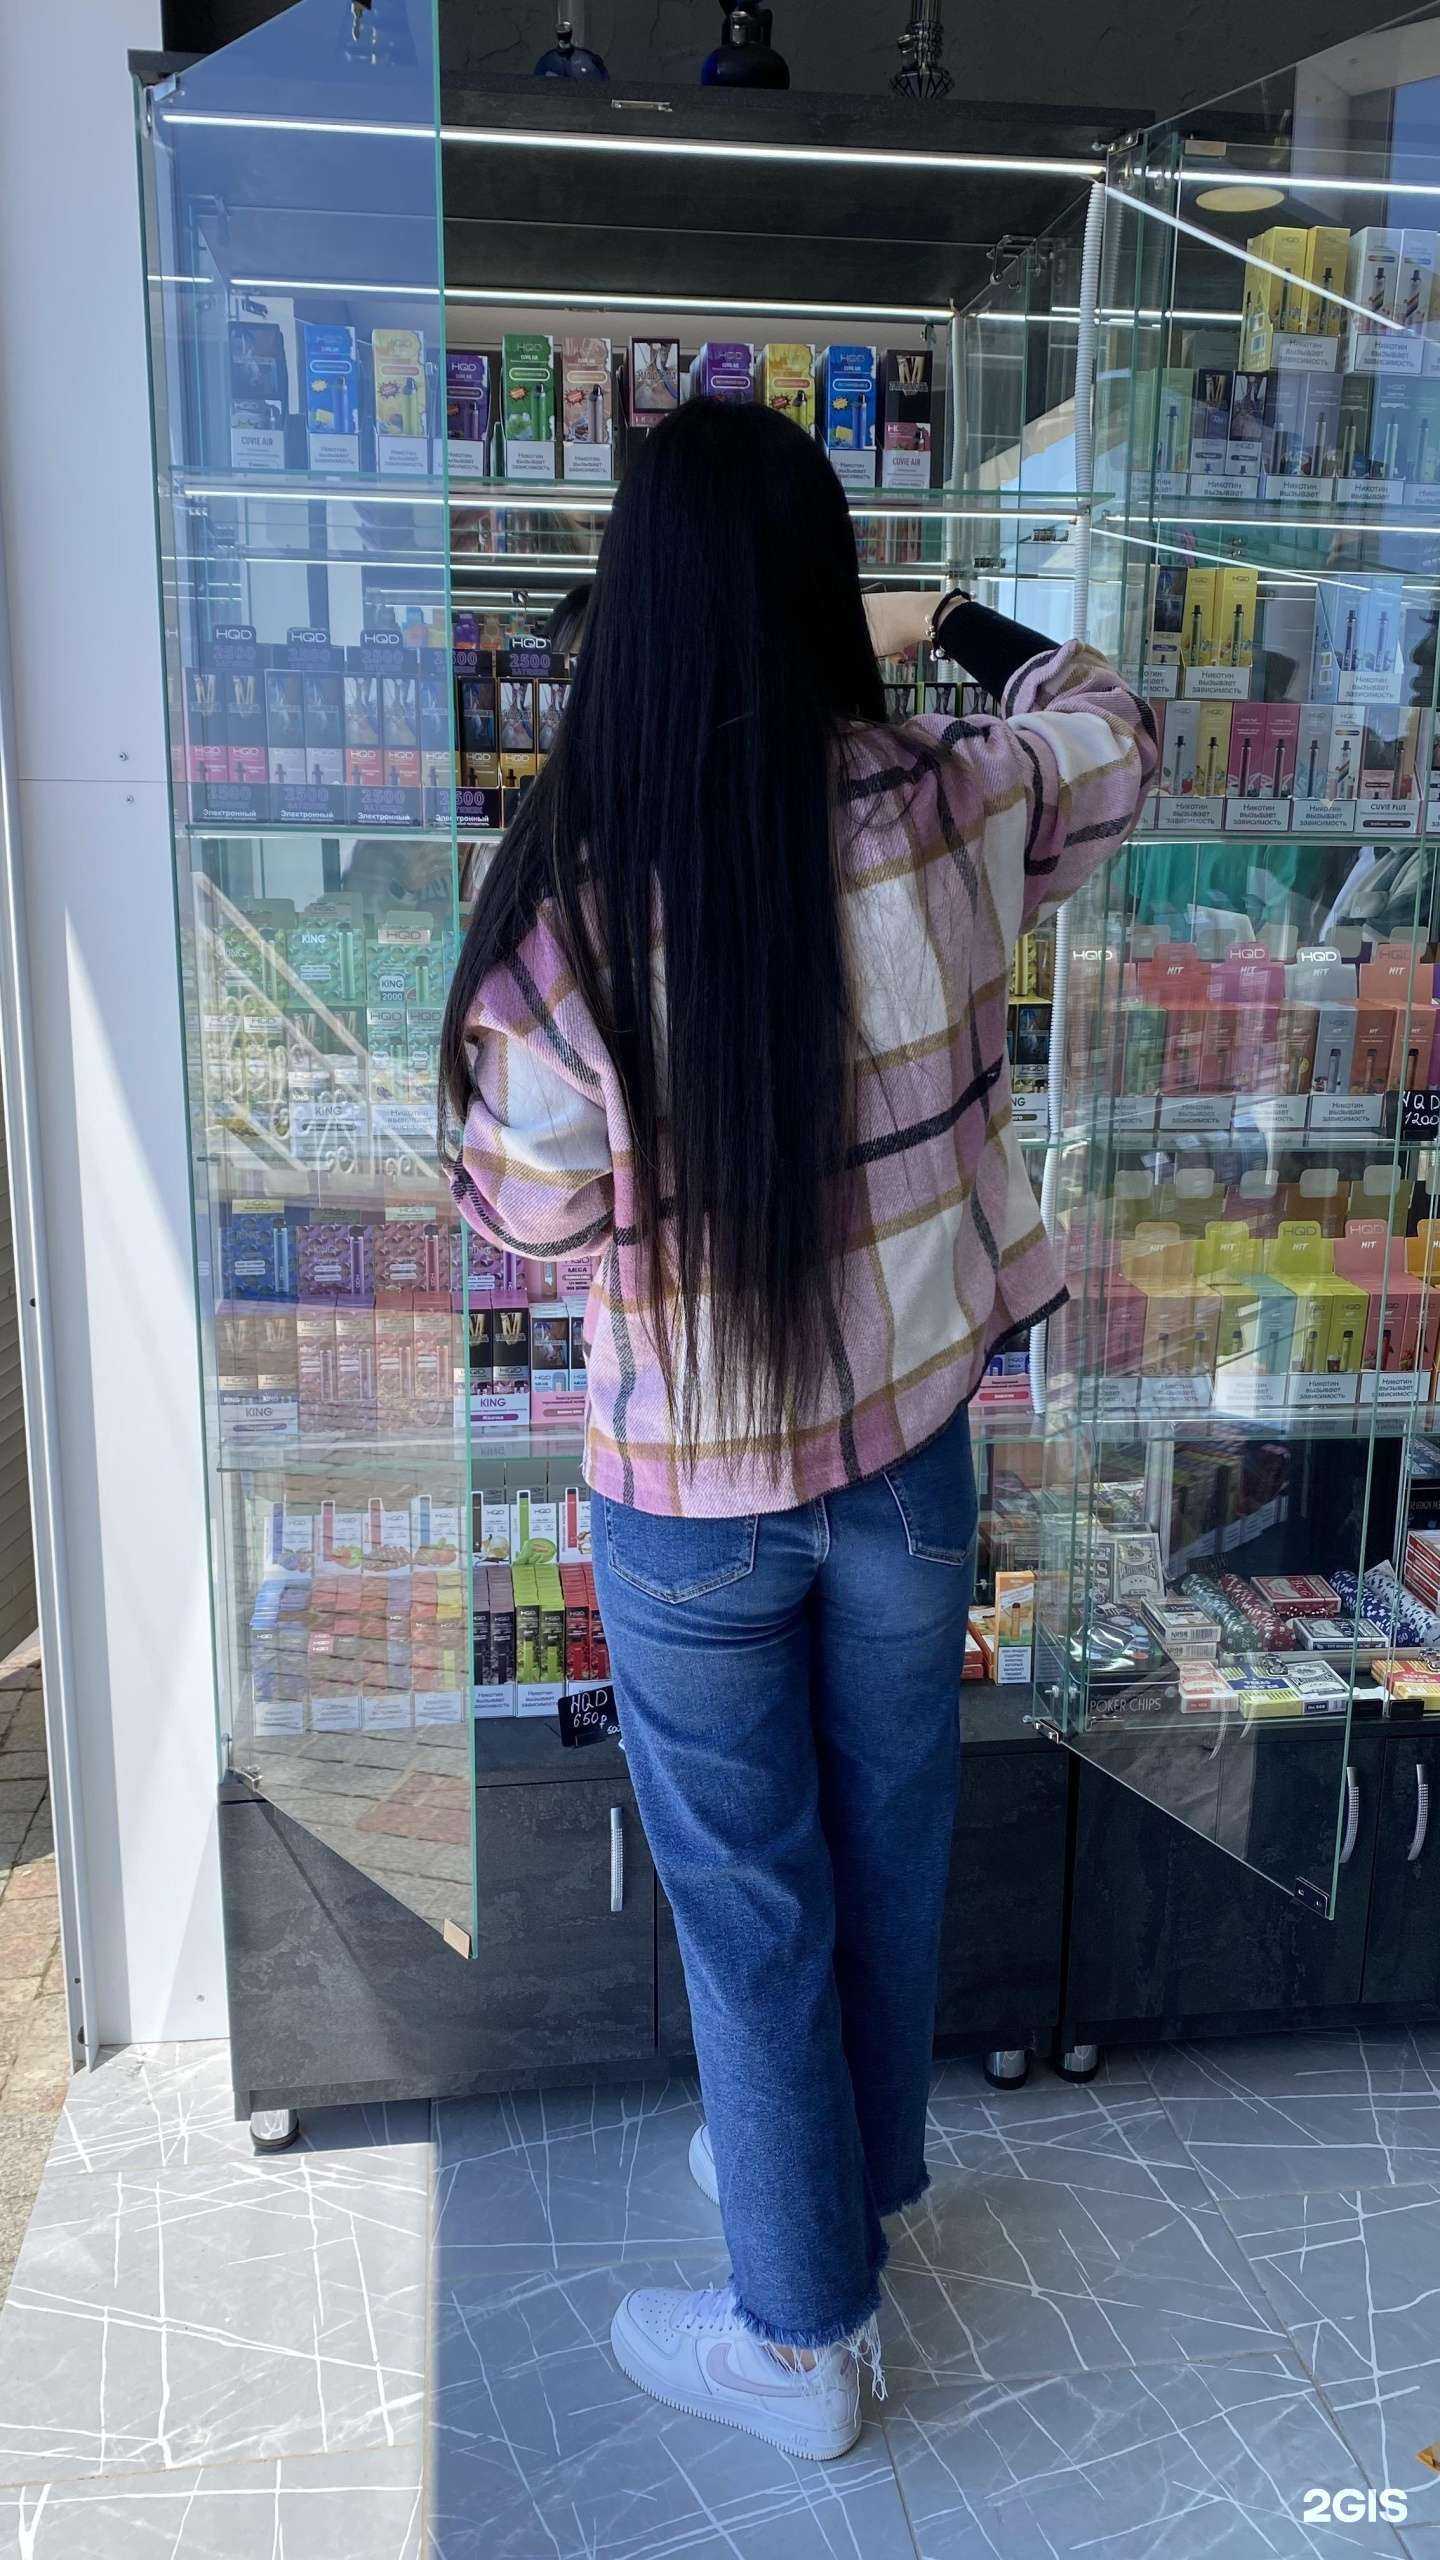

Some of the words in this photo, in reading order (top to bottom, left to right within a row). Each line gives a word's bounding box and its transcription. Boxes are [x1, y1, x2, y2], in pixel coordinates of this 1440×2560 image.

[216, 629, 253, 640] HQD
[291, 632, 328, 643] HQD
[364, 633, 400, 645] HQD
[512, 637, 548, 649] HQD
[510, 654, 550, 668] 2500
[302, 934, 327, 944] KING
[1230, 949, 1265, 959] HQD
[1301, 952, 1338, 962] HQD
[1167, 966, 1184, 975] HIT
[1313, 967, 1330, 976] HIT
[1389, 967, 1406, 976] HIT
[381, 979, 403, 989] KING
[382, 993, 403, 1001] 2000
[1361, 1241, 1376, 1249] HIT
[481, 1398, 506, 1407] KING
[245, 1407, 273, 1417] KING
[570, 1690, 608, 1714] HQD
[1090, 1699, 1126, 1713] POKER
[1129, 1697, 1161, 1711] CHIPS
